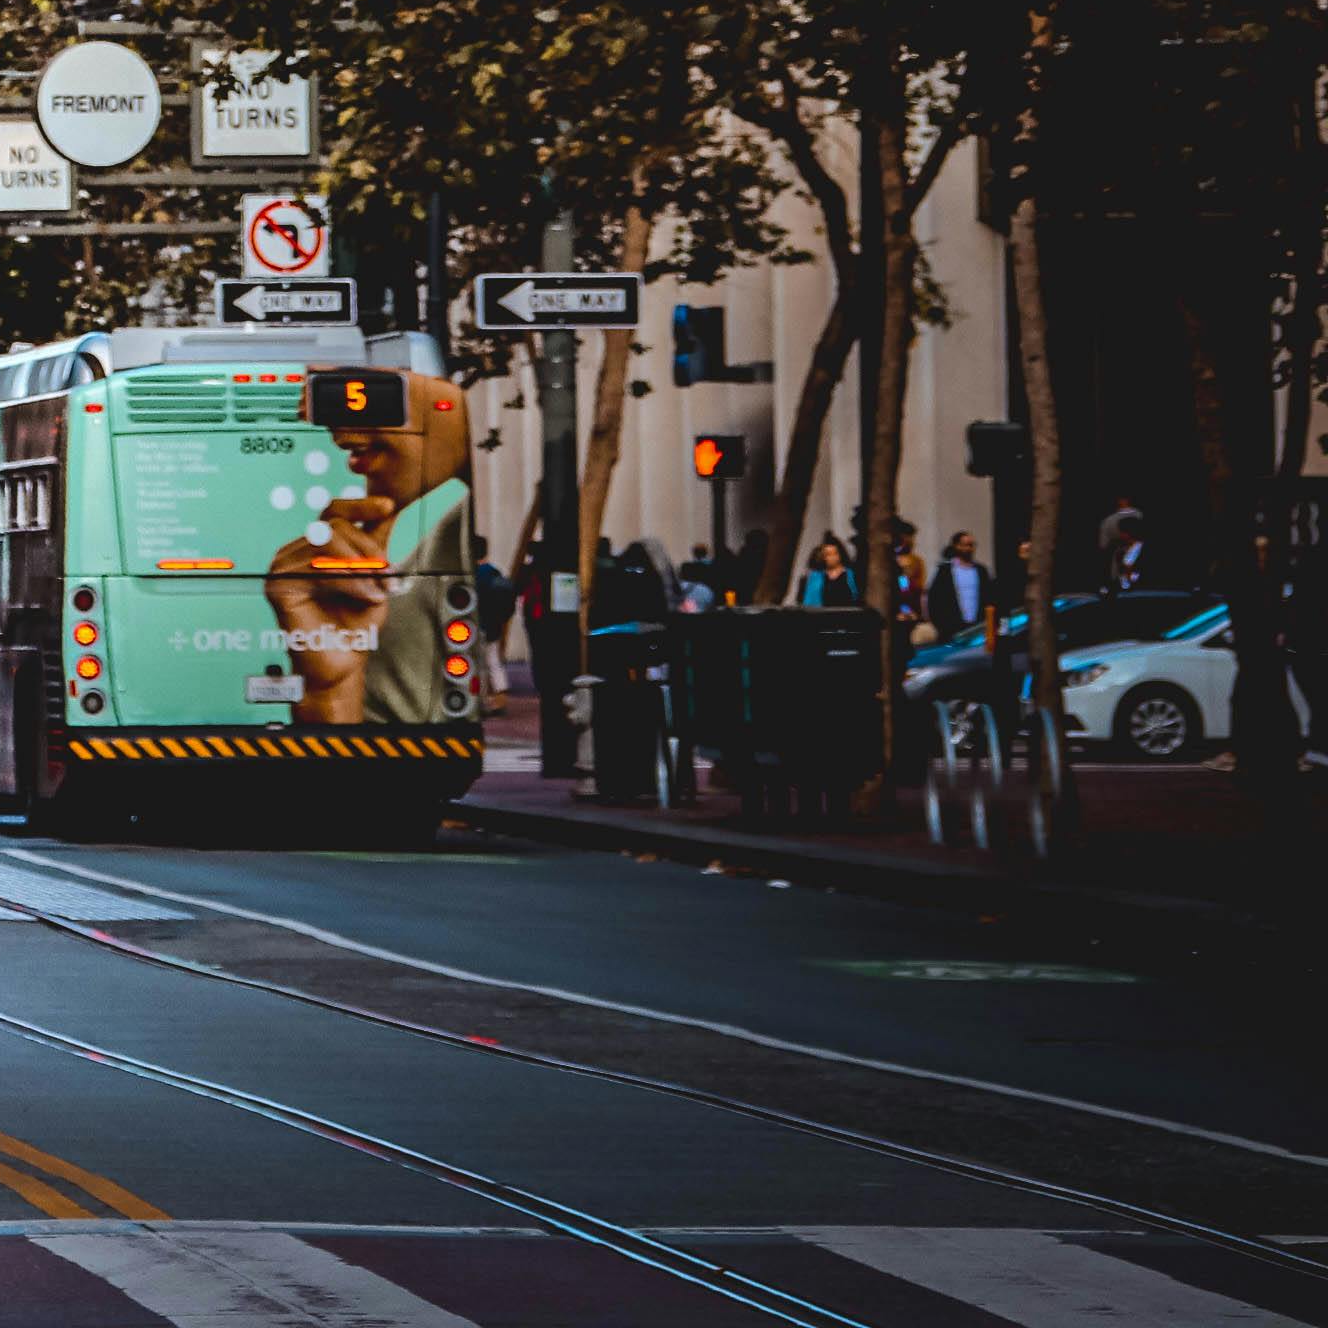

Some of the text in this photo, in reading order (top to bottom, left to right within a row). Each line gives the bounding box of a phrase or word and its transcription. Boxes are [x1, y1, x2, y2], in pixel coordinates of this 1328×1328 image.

[51, 95, 146, 114] FREMONT
[215, 107, 299, 129] TURNS
[9, 144, 39, 164] NO
[260, 295, 291, 309] ONE
[528, 294, 567, 310] ONE
[346, 382, 367, 411] 5
[240, 437, 295, 454] 8809
[193, 623, 379, 652] one medical
